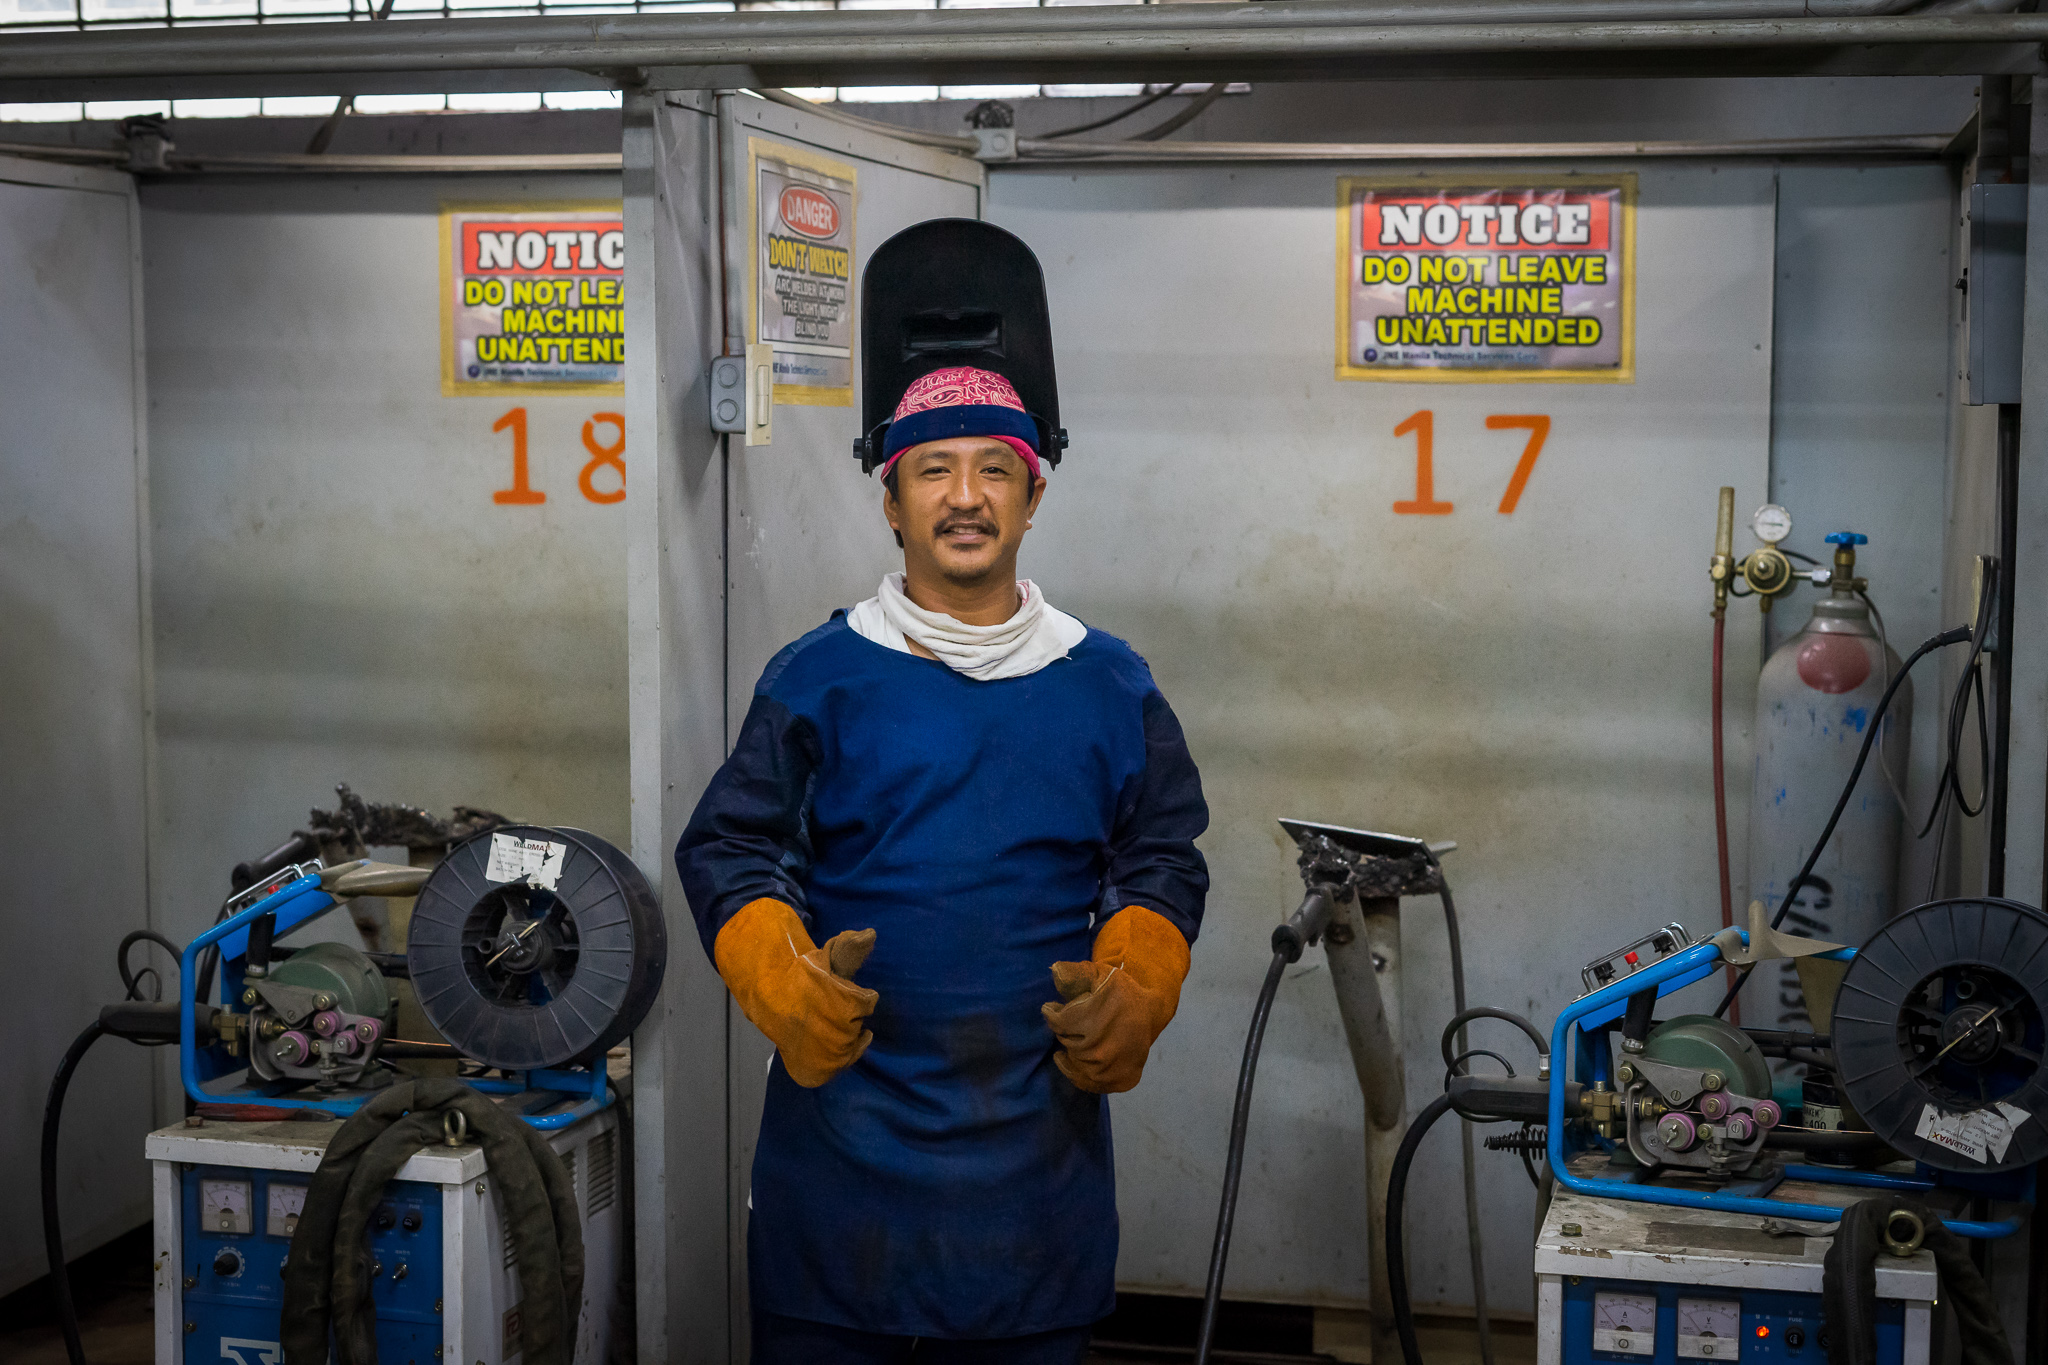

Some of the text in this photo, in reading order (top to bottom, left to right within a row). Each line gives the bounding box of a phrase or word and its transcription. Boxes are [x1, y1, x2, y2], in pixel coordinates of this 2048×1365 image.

[787, 194, 833, 231] DANGER
[1380, 204, 1590, 245] NOTICE
[477, 230, 624, 270] NOTIC
[769, 236, 849, 280] DON'T WATCH
[1363, 255, 1606, 284] DO NOT LEAVE
[465, 280, 504, 305] DO
[513, 280, 573, 305] NOT
[775, 276, 791, 294] ARC
[792, 279, 817, 300] WELDER
[819, 284, 829, 300] AT
[1407, 287, 1562, 314] MACHINE
[503, 308, 624, 333] MACHIN
[782, 297, 798, 315] THE
[799, 300, 818, 318] LIGHT
[795, 319, 830, 338] BLIND YOU
[1376, 318, 1601, 346] UNATTENDED
[1932, 1131, 1976, 1155] WELDMAX
